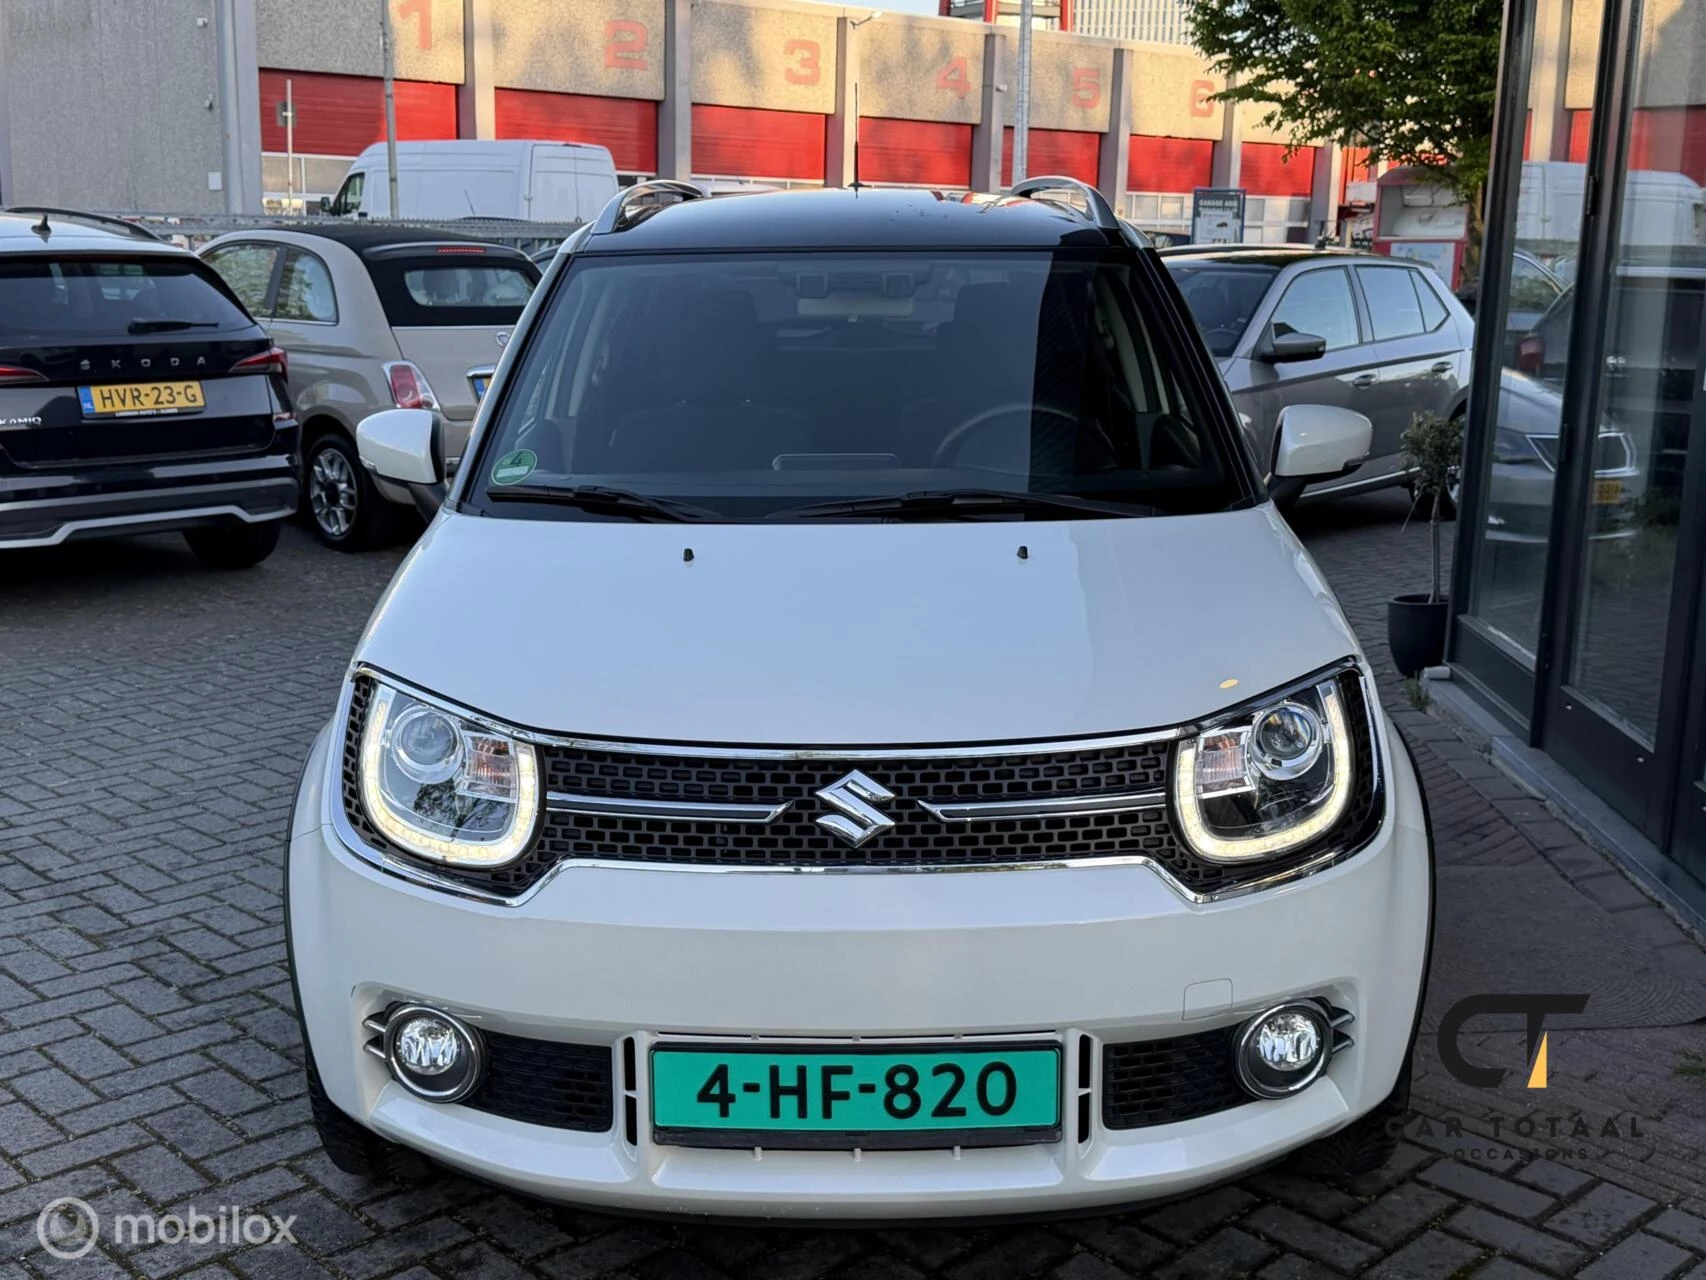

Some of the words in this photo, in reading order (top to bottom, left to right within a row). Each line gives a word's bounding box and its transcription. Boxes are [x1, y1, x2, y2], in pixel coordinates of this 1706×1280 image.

[400, 0, 432, 50] 1
[604, 19, 648, 71] 2
[784, 38, 820, 86] 3
[936, 56, 971, 99] 4
[1072, 67, 1101, 109] 5
[1188, 80, 1215, 118] 6
[100, 385, 198, 408] HVR-23-G
[510, 452, 522, 467] 4
[697, 1061, 1017, 1119] 4-HF-820
